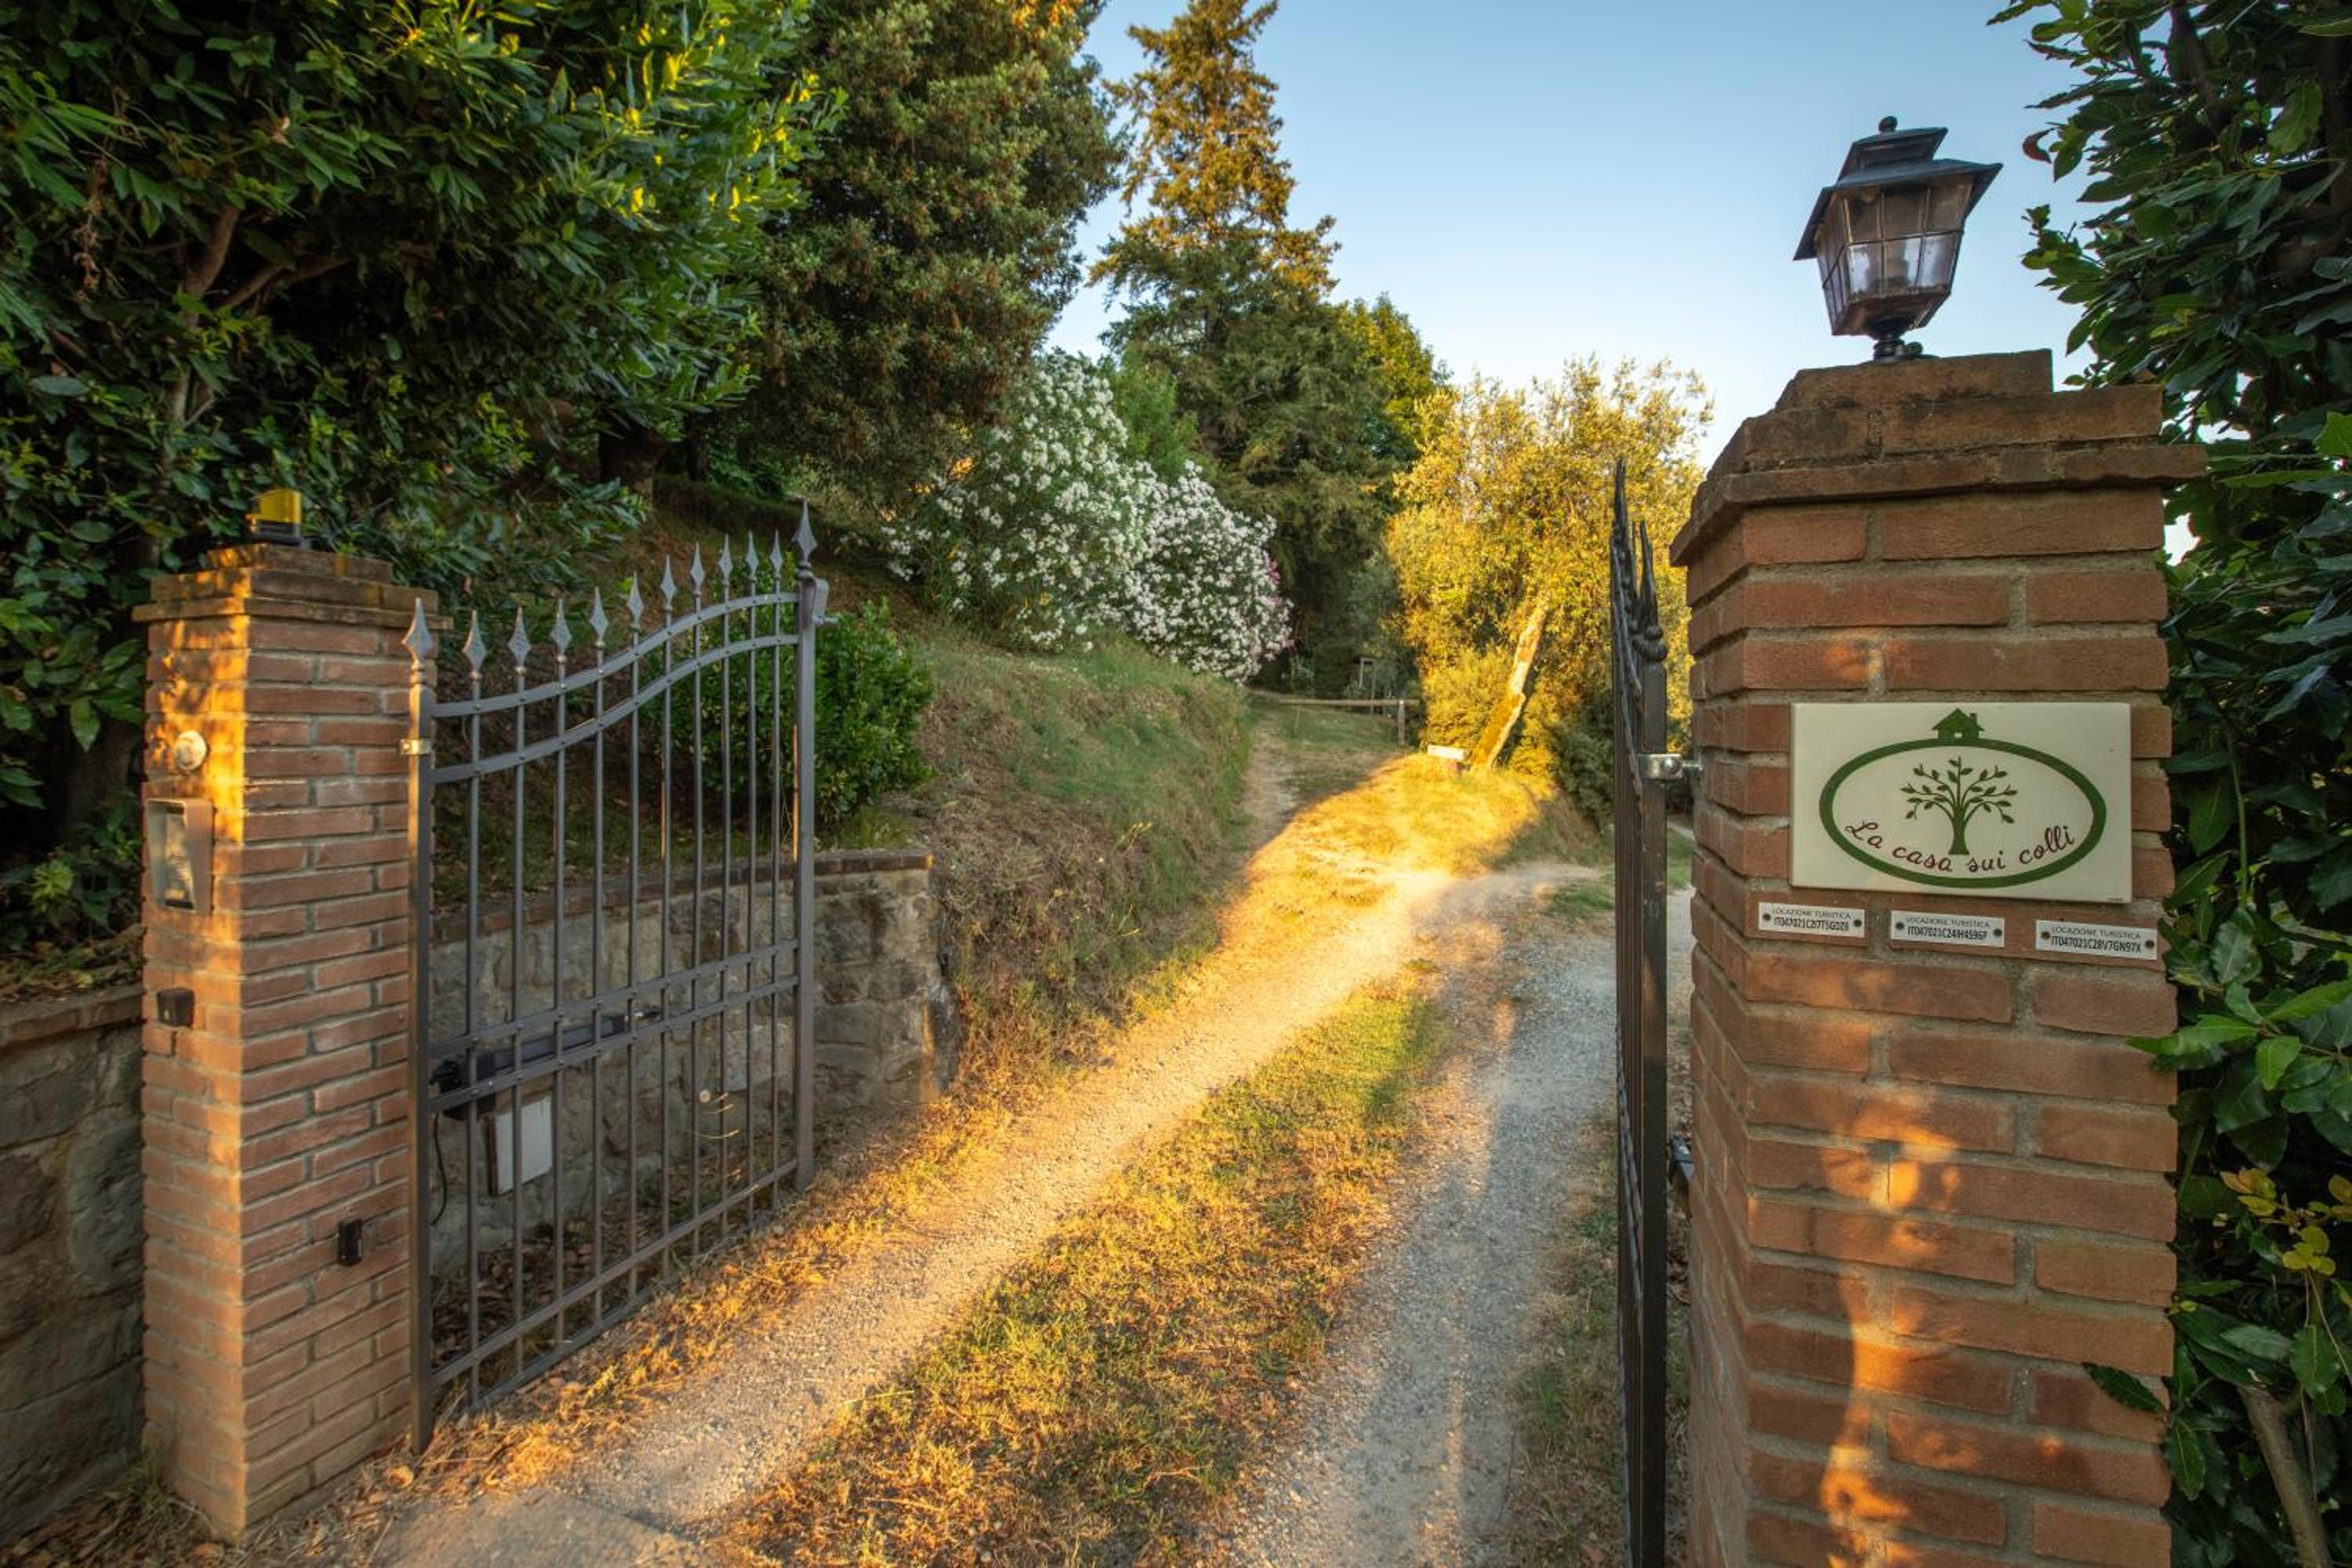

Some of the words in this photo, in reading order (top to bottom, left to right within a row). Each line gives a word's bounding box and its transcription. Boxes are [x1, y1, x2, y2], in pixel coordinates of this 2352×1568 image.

[1845, 819, 1883, 850] La
[1892, 846, 1953, 872] casa
[1965, 850, 2007, 872] sui
[2019, 825, 2075, 865] colli
[1773, 907, 1812, 917] LOCAZIONE
[1815, 910, 1851, 920] TURISTICA
[1907, 916, 1947, 926] LOCAZIONE
[1951, 919, 1990, 928] TURISTICA
[2052, 926, 2096, 936] LOCAZIONE
[2100, 929, 2141, 940] TURISTICA
